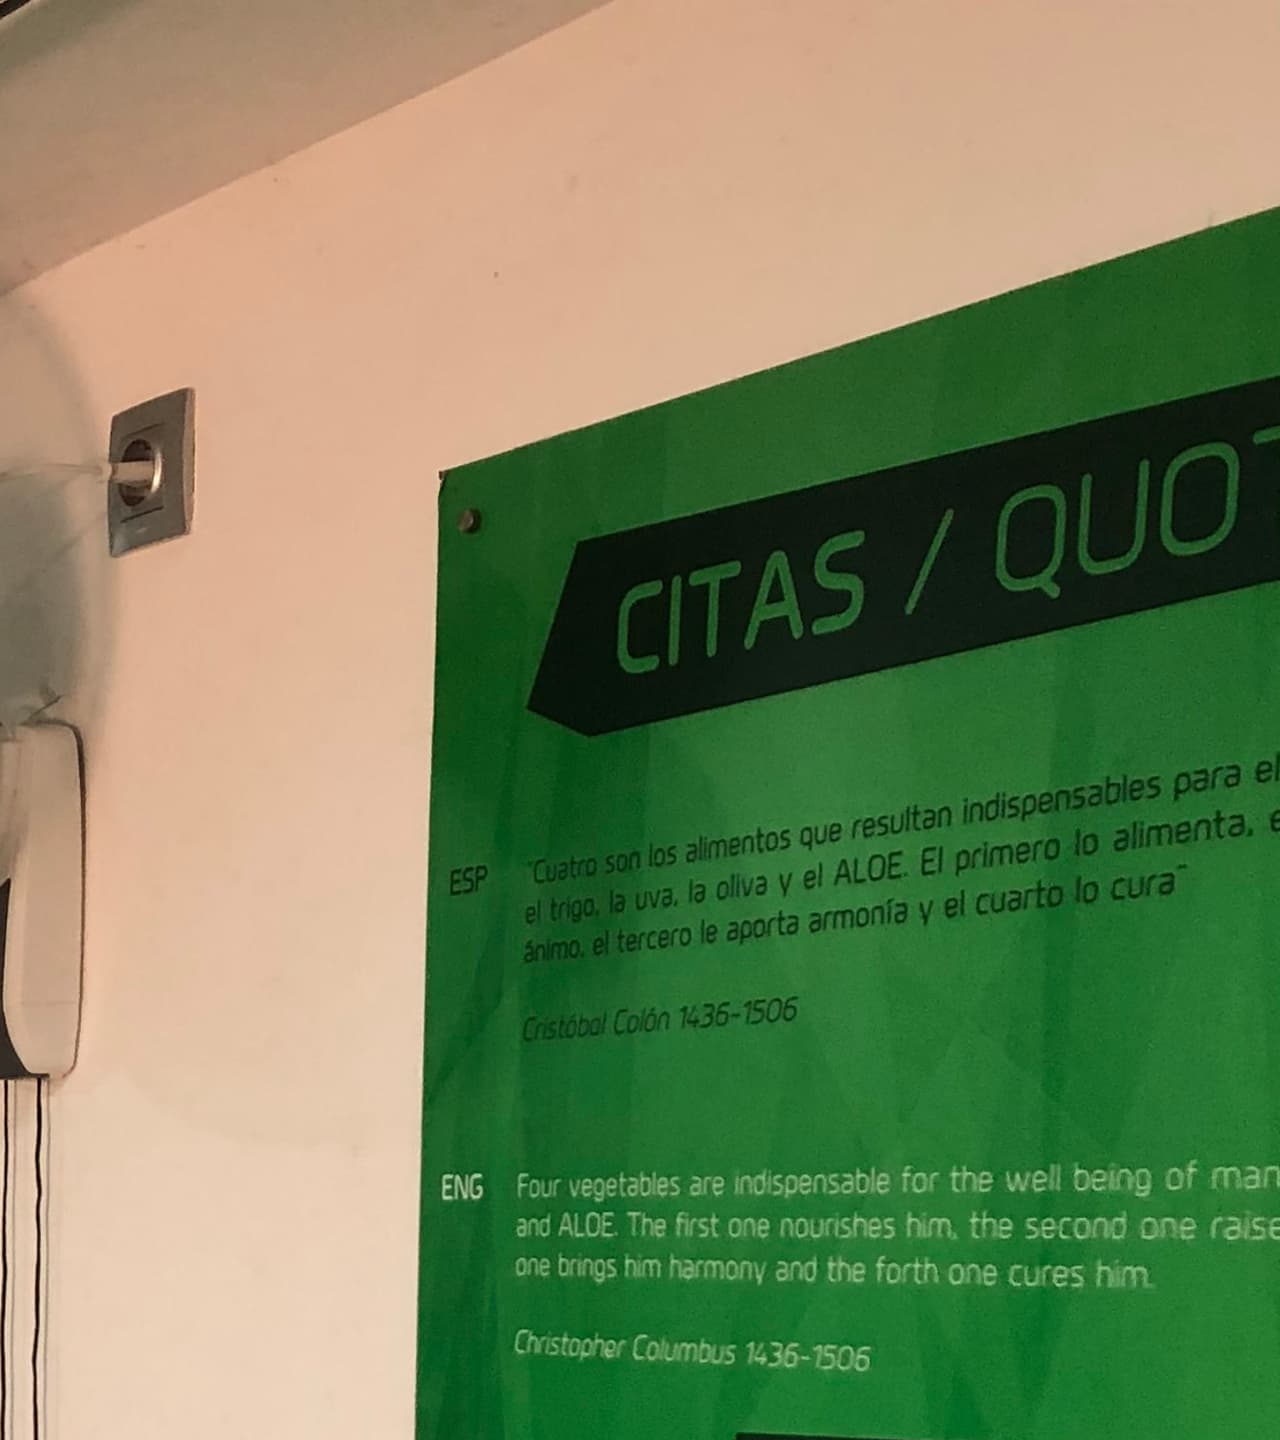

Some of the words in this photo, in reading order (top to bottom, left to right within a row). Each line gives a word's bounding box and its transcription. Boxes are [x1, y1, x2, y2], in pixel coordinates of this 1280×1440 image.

[616, 530, 866, 676] CITAS
[905, 508, 955, 616] /
[605, 849, 640, 875] son
[649, 842, 677, 868] los
[685, 827, 791, 864] alimentos
[800, 821, 842, 851] que
[852, 803, 953, 841] resultan
[963, 774, 1161, 825] indispensables
[1173, 763, 1241, 801] para
[449, 864, 488, 897] ESP
[525, 895, 541, 926] el
[550, 897, 600, 926] trigo,
[609, 887, 626, 914] la
[635, 888, 679, 912] uva,
[688, 878, 707, 905] la
[716, 872, 768, 900] oliva
[778, 870, 793, 898] y
[803, 862, 824, 889] el
[833, 850, 909, 887] ALOE.
[921, 846, 943, 877] El
[955, 835, 1061, 877] primero
[1074, 827, 1099, 857] lo
[1113, 809, 1254, 855] alimenta,
[522, 935, 585, 964] ánimo,
[592, 930, 610, 956] el
[617, 925, 692, 953] tercero
[700, 918, 717, 945] le
[726, 911, 800, 944] aporta
[809, 896, 908, 934] armonía
[919, 900, 934, 926] y
[944, 889, 966, 919] el
[976, 880, 1064, 917] cuarto
[1075, 876, 1099, 904] lo
[522, 1008, 608, 1043] Cristóbal
[613, 1005, 671, 1036] Colón
[679, 996, 800, 1030] 1436-1506
[441, 1172, 484, 1201] ENG
[517, 1172, 562, 1199] Four
[568, 1171, 682, 1203] vegetables
[689, 1174, 726, 1196] are
[734, 1167, 891, 1198] indispensable
[902, 1165, 940, 1194] for
[950, 1165, 994, 1194] the
[1006, 1163, 1062, 1193] well
[1073, 1161, 1153, 1198] being
[1165, 1159, 1199, 1191] of
[516, 1213, 552, 1238] and
[558, 1211, 619, 1239] ALOE.
[627, 1210, 667, 1239] The
[675, 1211, 719, 1239] first
[728, 1214, 771, 1239] one
[780, 1211, 896, 1240] nourishes
[905, 1211, 958, 1241] him,
[970, 1211, 1013, 1240] the
[1025, 1211, 1128, 1241] second
[1140, 1216, 1197, 1241] one
[515, 1254, 551, 1278] one
[558, 1251, 618, 1283] brings
[624, 1252, 662, 1280] him
[669, 1254, 766, 1285] harmony
[775, 1256, 818, 1283] and
[827, 1256, 867, 1283] the
[875, 1255, 940, 1286] forth
[948, 1261, 998, 1286] one
[1007, 1263, 1085, 1289] cures
[1096, 1257, 1155, 1290] him.
[514, 1328, 628, 1362] Christopher
[632, 1333, 737, 1366] Columbus
[746, 1340, 872, 1373] 1436-1506
